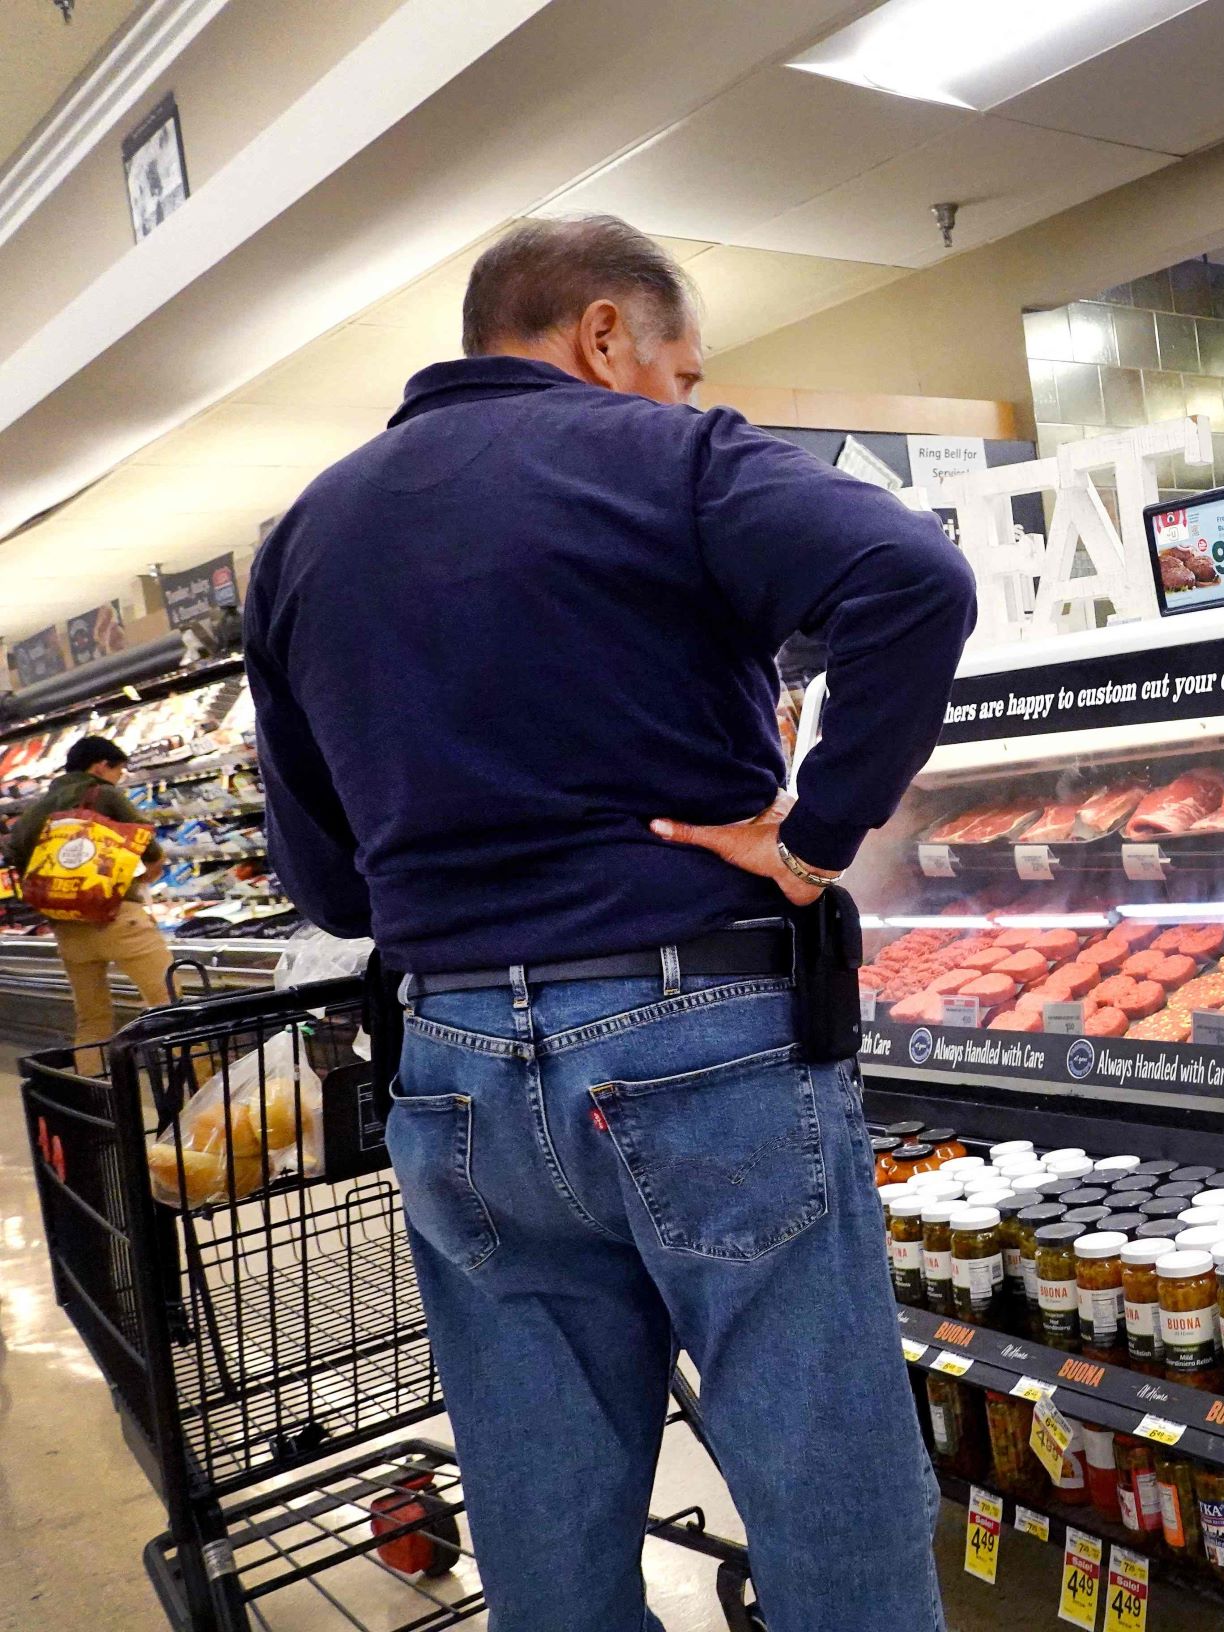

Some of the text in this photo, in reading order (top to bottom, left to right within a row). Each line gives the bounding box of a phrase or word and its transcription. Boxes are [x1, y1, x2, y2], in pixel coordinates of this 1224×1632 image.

[918, 447, 978, 461] Ring Bell for
[979, 698, 1004, 719] are
[1007, 693, 1054, 720] happy
[1058, 686, 1074, 709] to
[1077, 679, 1137, 708] custom
[1141, 673, 1170, 699] cut
[1172, 673, 1217, 703] your
[860, 1036, 892, 1056] ith Care
[933, 1036, 1045, 1070] Always Handled with Care
[1096, 1048, 1133, 1085] Always
[1134, 1052, 1179, 1082] Handled
[1180, 1056, 1205, 1084] with
[1040, 1285, 1068, 1298] BUONA
[933, 1320, 976, 1346] BUONA
[1167, 1316, 1202, 1331] BUONA
[1057, 1358, 1105, 1388] BUONA
[971, 1527, 995, 1554] 449
[1072, 1556, 1093, 1572] Sale!
[1067, 1569, 1094, 1600] 449
[1116, 1576, 1140, 1593] Sale!
[1112, 1589, 1142, 1620] 449
